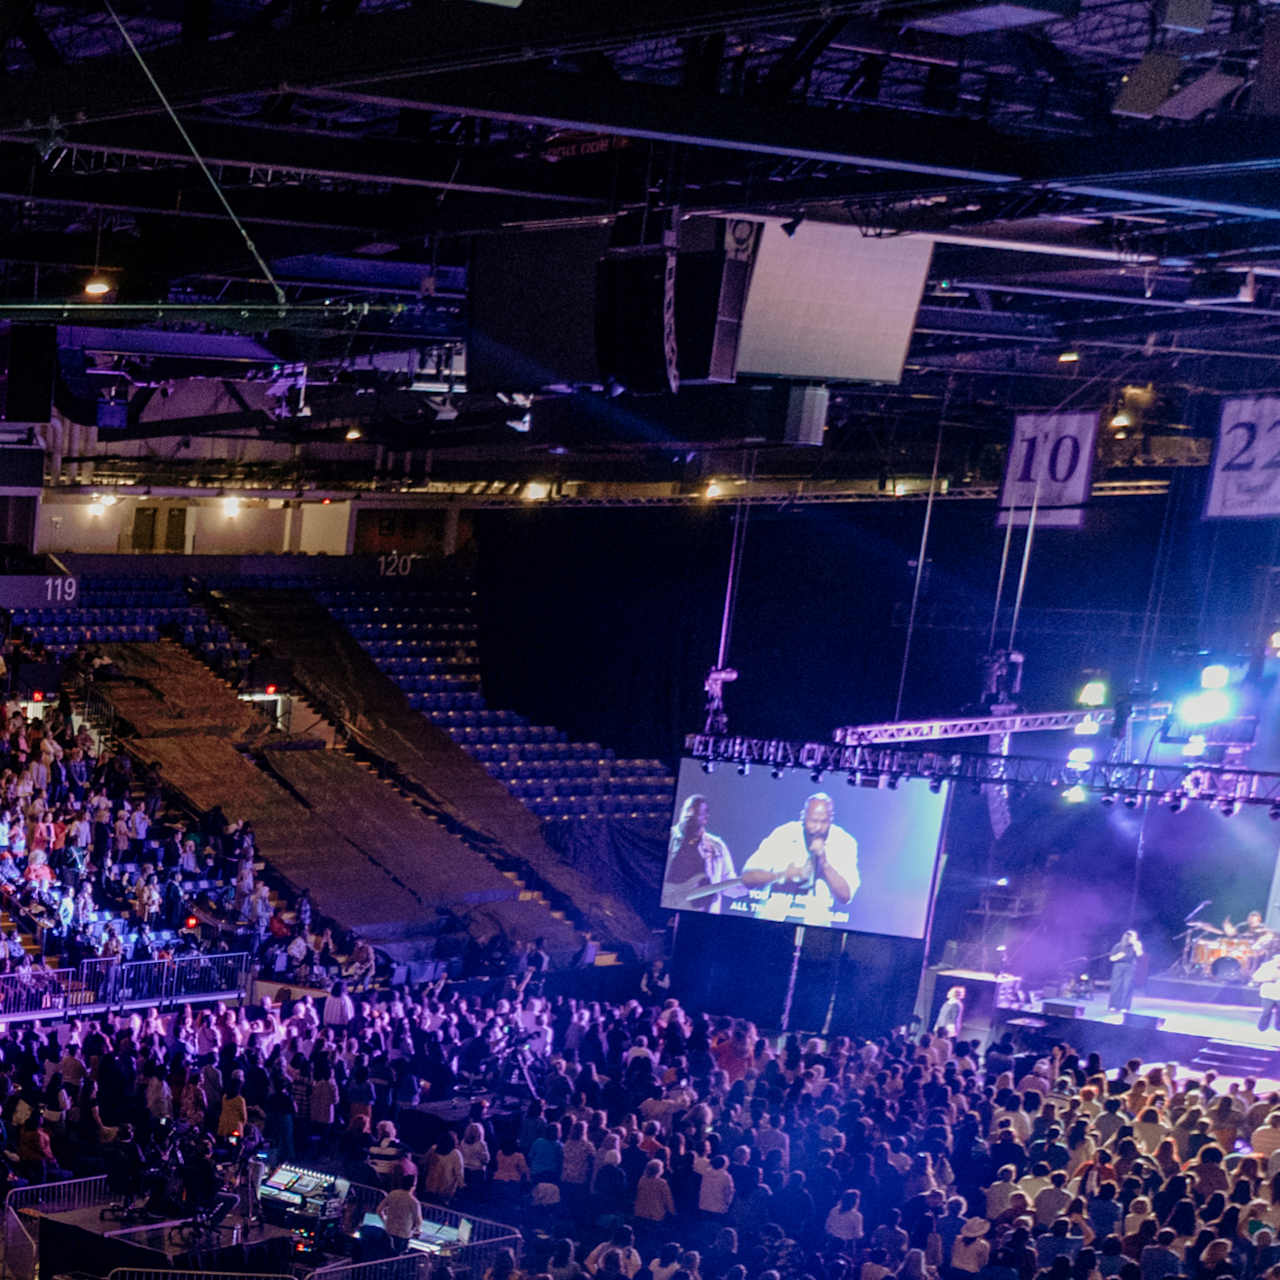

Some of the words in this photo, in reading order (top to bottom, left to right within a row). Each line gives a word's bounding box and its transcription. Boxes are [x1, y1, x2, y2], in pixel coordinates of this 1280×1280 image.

[1015, 434, 1081, 484] 10
[378, 555, 412, 576] 120
[45, 578, 77, 601] 119
[729, 902, 749, 912] ALL
